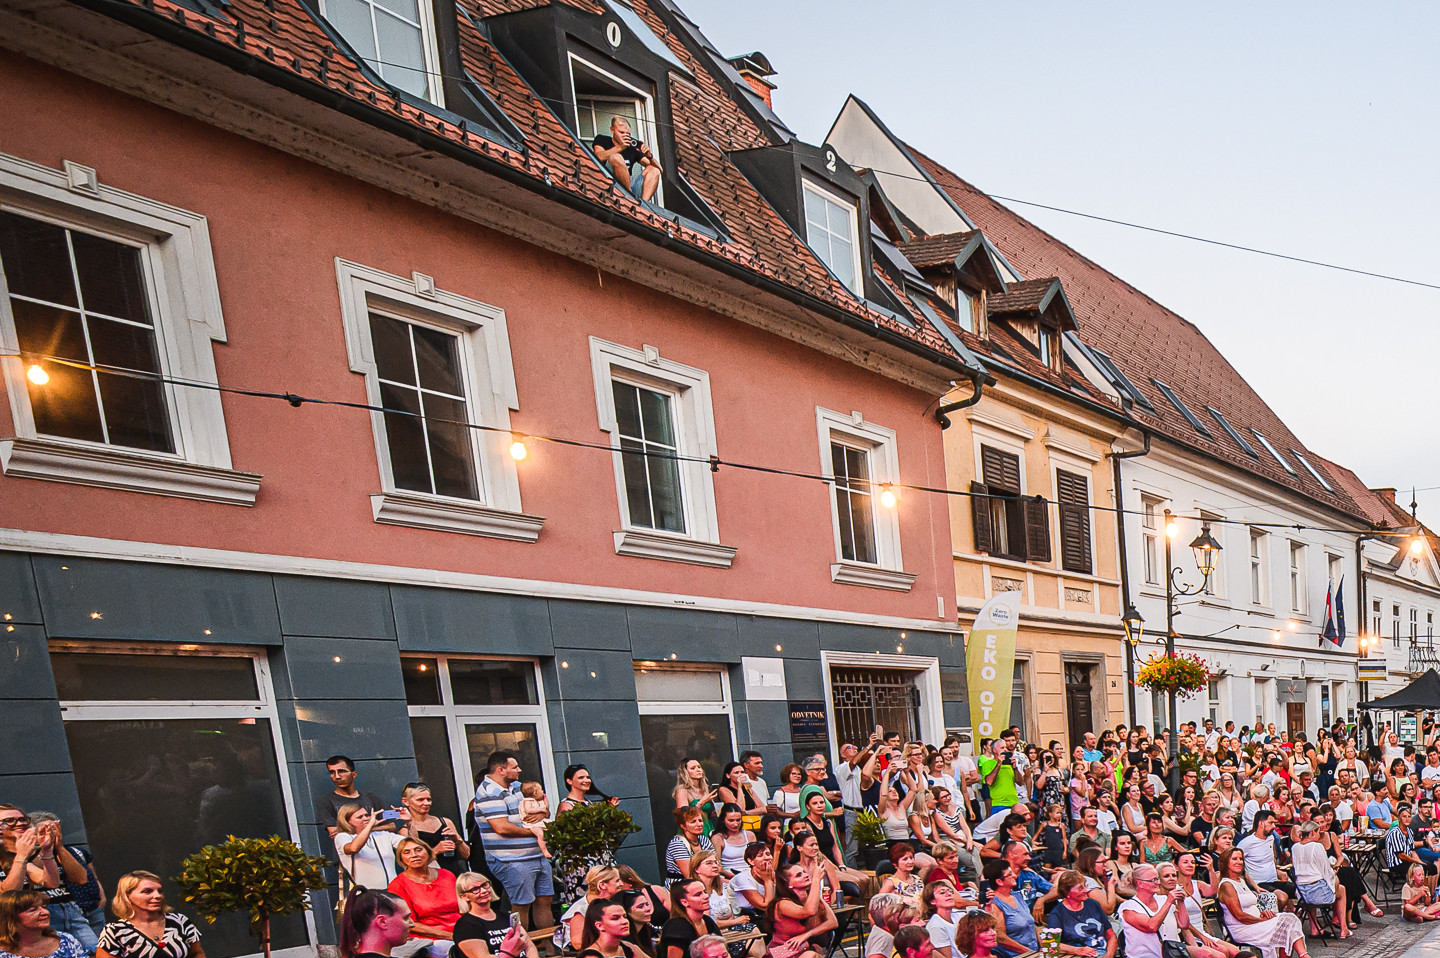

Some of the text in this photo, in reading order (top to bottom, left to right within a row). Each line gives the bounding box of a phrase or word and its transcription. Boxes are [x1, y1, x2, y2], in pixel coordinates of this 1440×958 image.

[826, 150, 838, 173] 2
[981, 634, 997, 681] EKO
[791, 711, 825, 719] ODVETNIK
